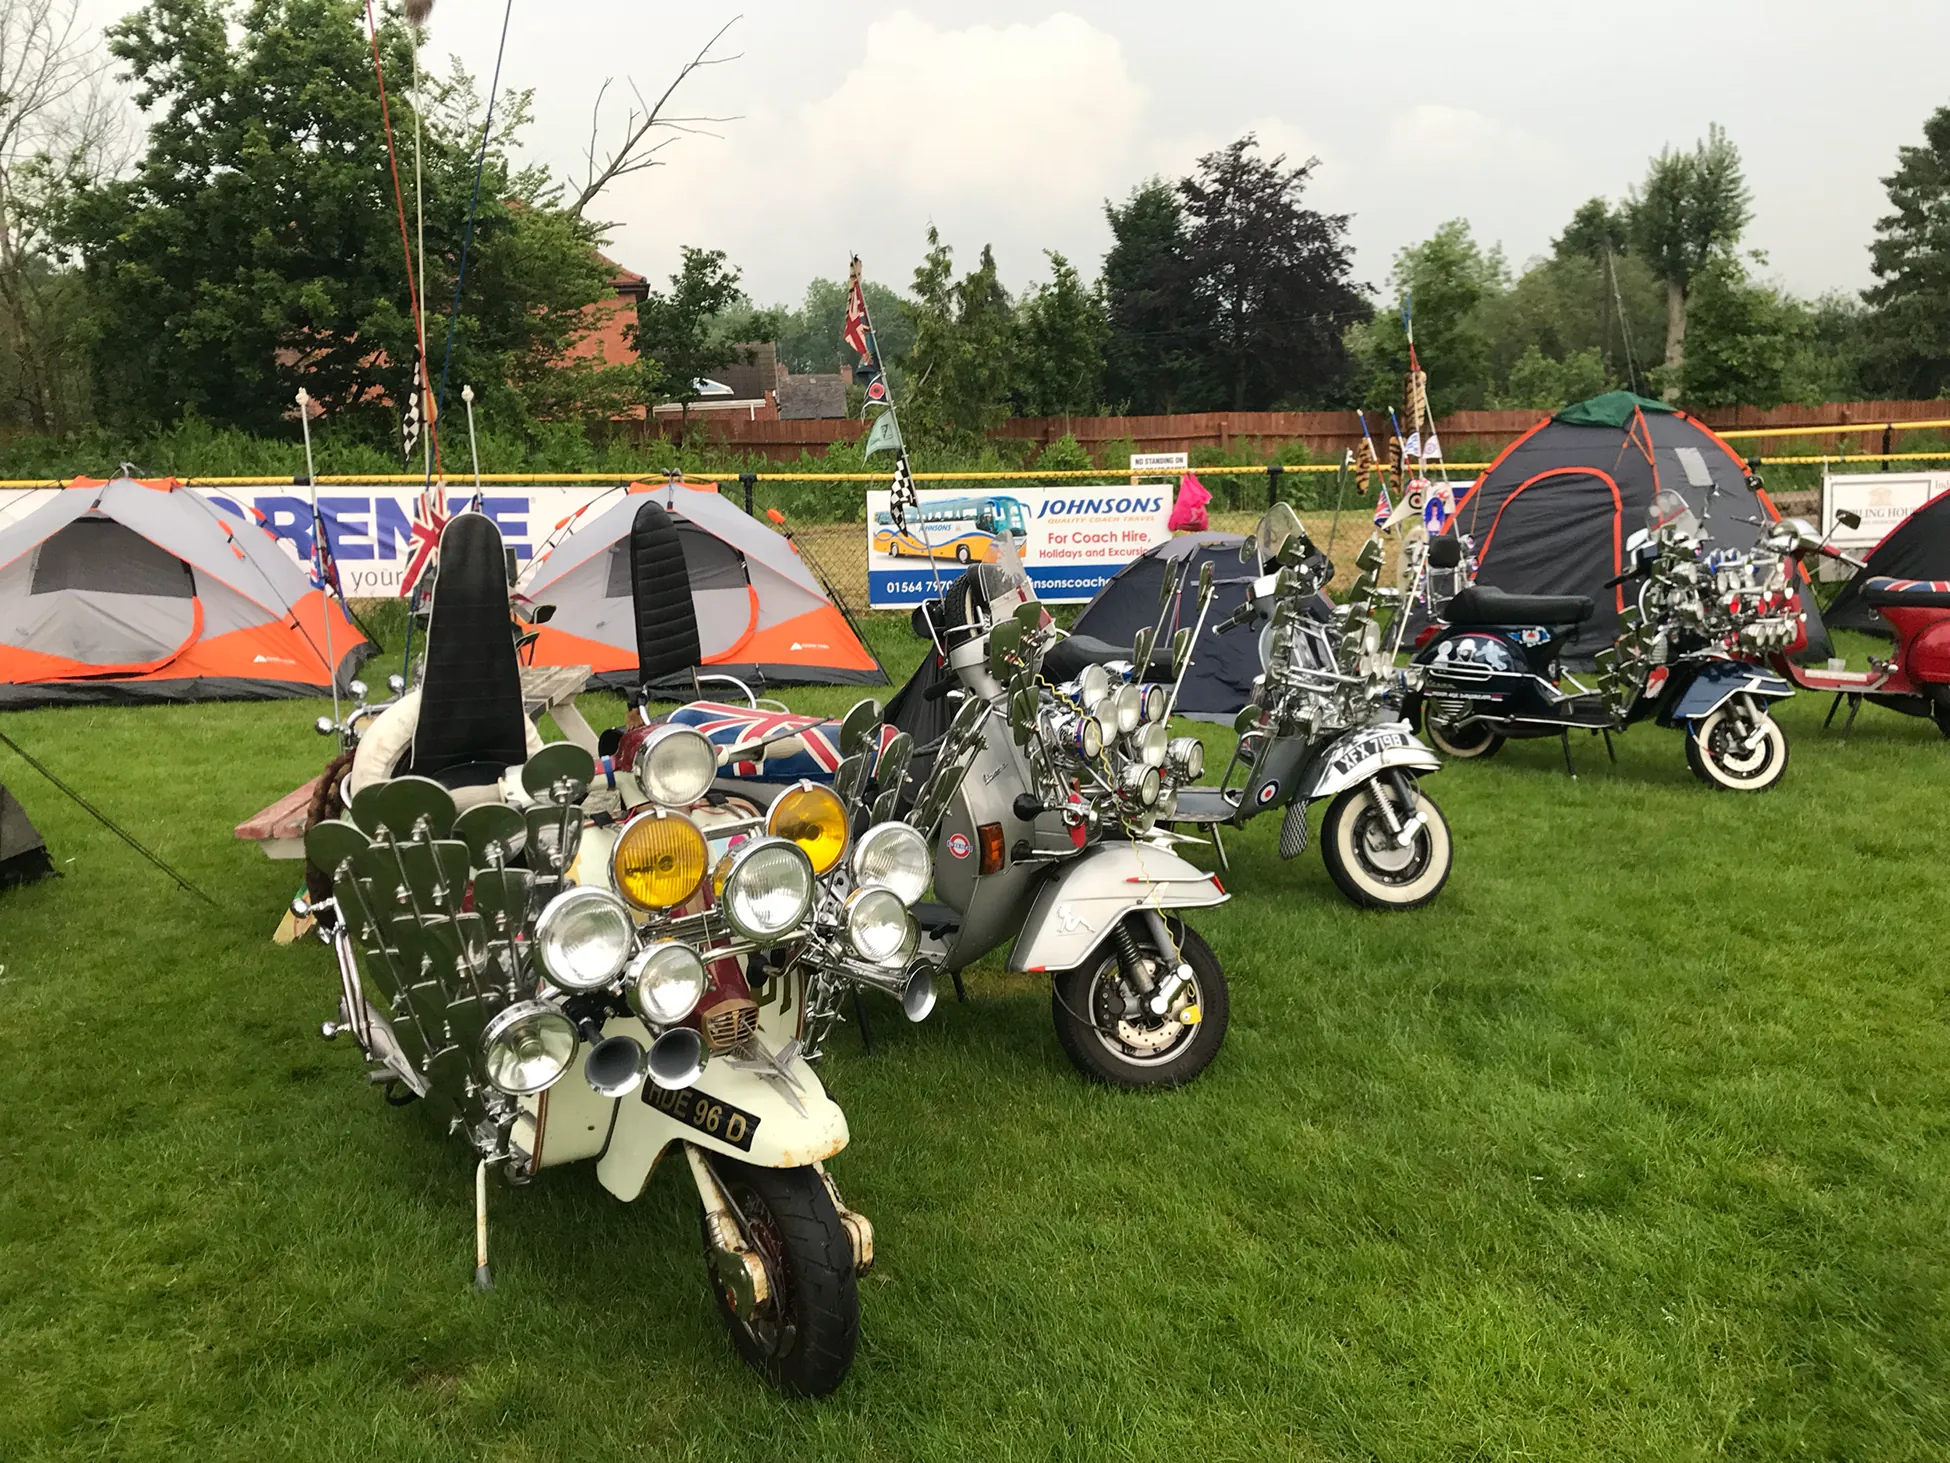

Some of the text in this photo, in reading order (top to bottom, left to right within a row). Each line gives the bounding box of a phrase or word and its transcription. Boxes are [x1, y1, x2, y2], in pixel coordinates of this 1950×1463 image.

[1145, 457, 1174, 465] STANDING
[1175, 456, 1184, 464] ON
[1036, 497, 1163, 519] JOHNSONS
[1887, 507, 1916, 518] HOU
[1048, 517, 1086, 525] QUALITY
[919, 524, 951, 532] JHNSONS
[1048, 530, 1151, 544] For Coach Hire,
[1039, 549, 1082, 559] Holidays
[1085, 547, 1105, 558] and
[351, 571, 403, 592] your
[886, 581, 922, 593] 01564
[1370, 734, 1403, 753] 719B
[693, 1099, 722, 1132] 96
[725, 1112, 747, 1142] D
